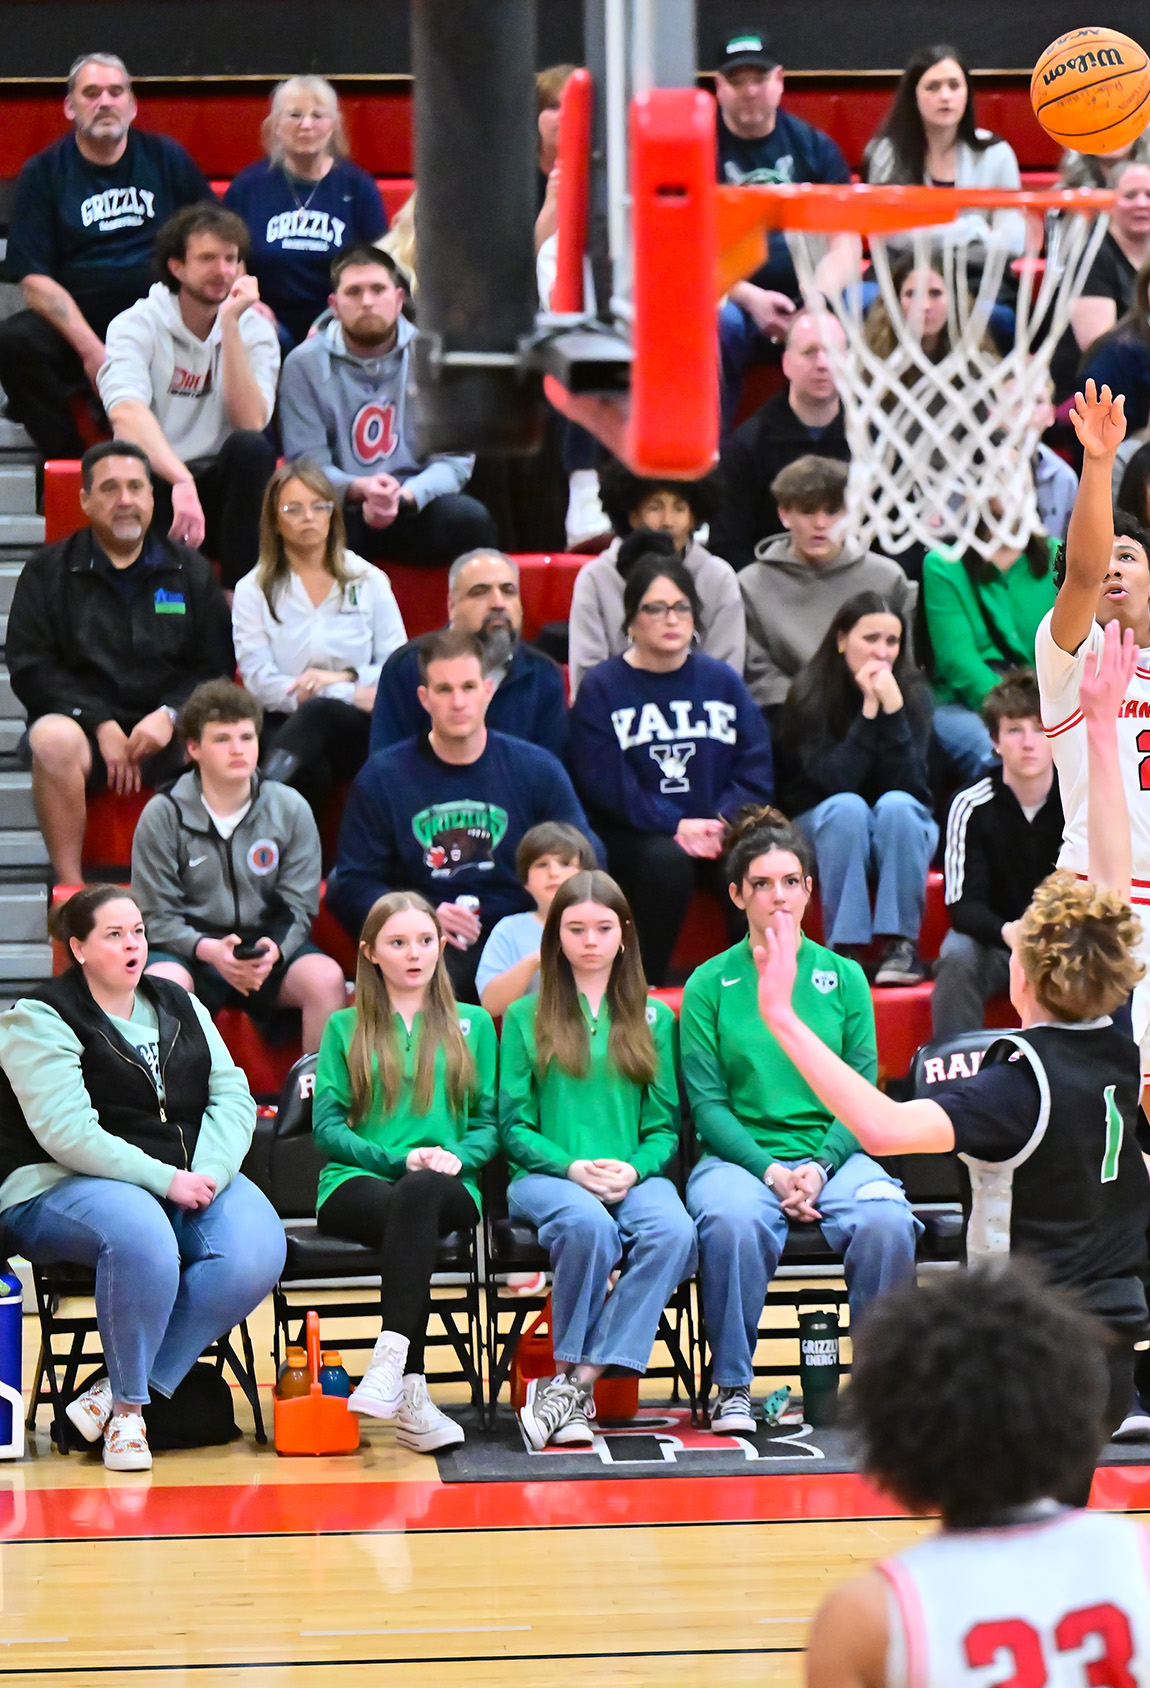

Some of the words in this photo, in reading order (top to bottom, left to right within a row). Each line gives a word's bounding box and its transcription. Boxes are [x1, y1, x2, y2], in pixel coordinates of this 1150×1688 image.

[1043, 48, 1124, 86] Wilson
[81, 186, 155, 227] GRIZZLY
[266, 209, 346, 247] GRIZZLY
[611, 700, 737, 751] YALE
[1101, 1085, 1124, 1183] 1
